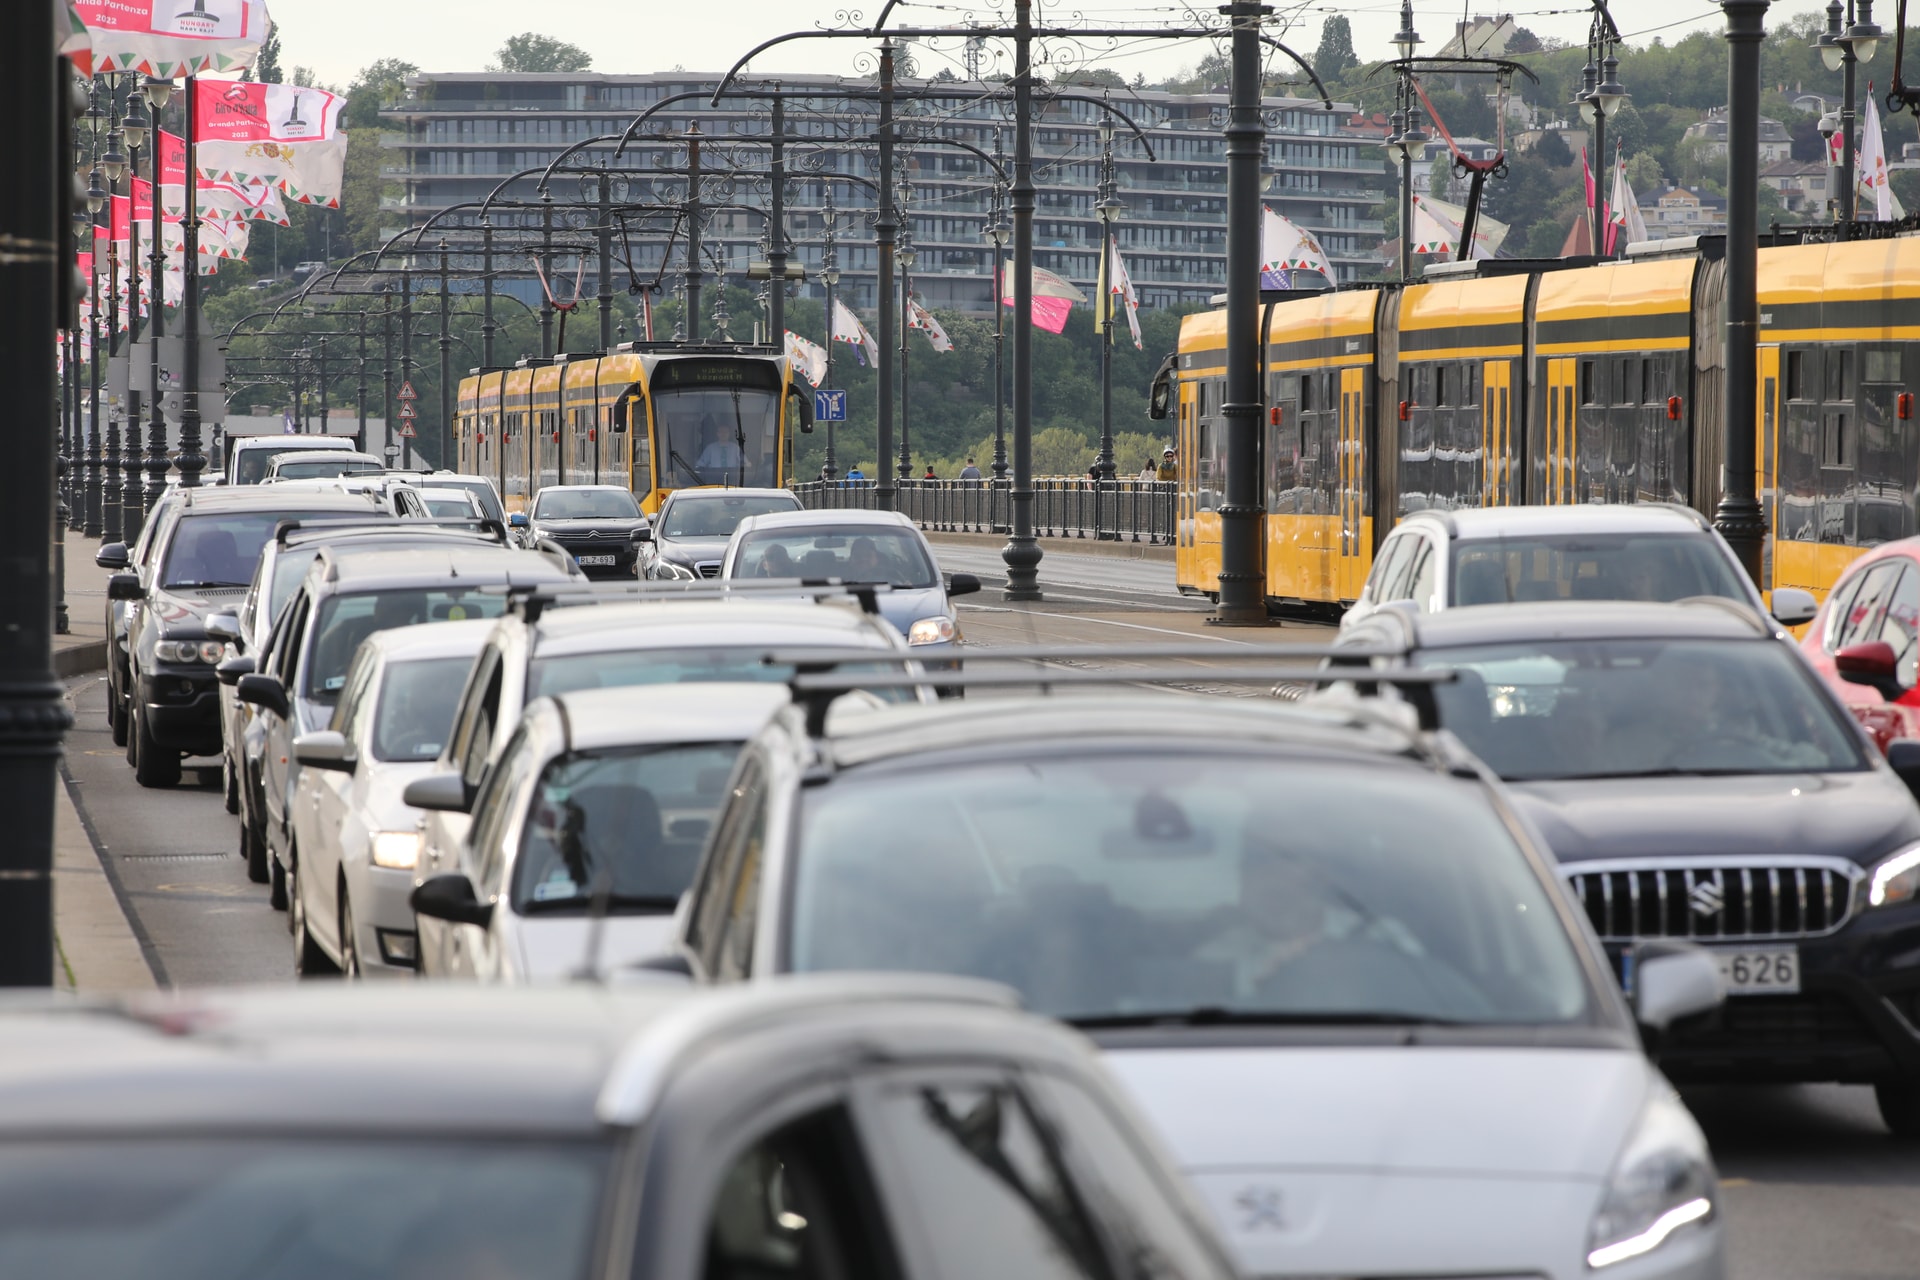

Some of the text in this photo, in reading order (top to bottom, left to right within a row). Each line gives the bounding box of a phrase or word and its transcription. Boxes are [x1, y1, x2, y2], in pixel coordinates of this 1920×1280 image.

[104, 0, 148, 15] Partenza
[95, 13, 117, 25] 2022
[215, 102, 232, 114] Giro
[671, 364, 679, 381] 4
